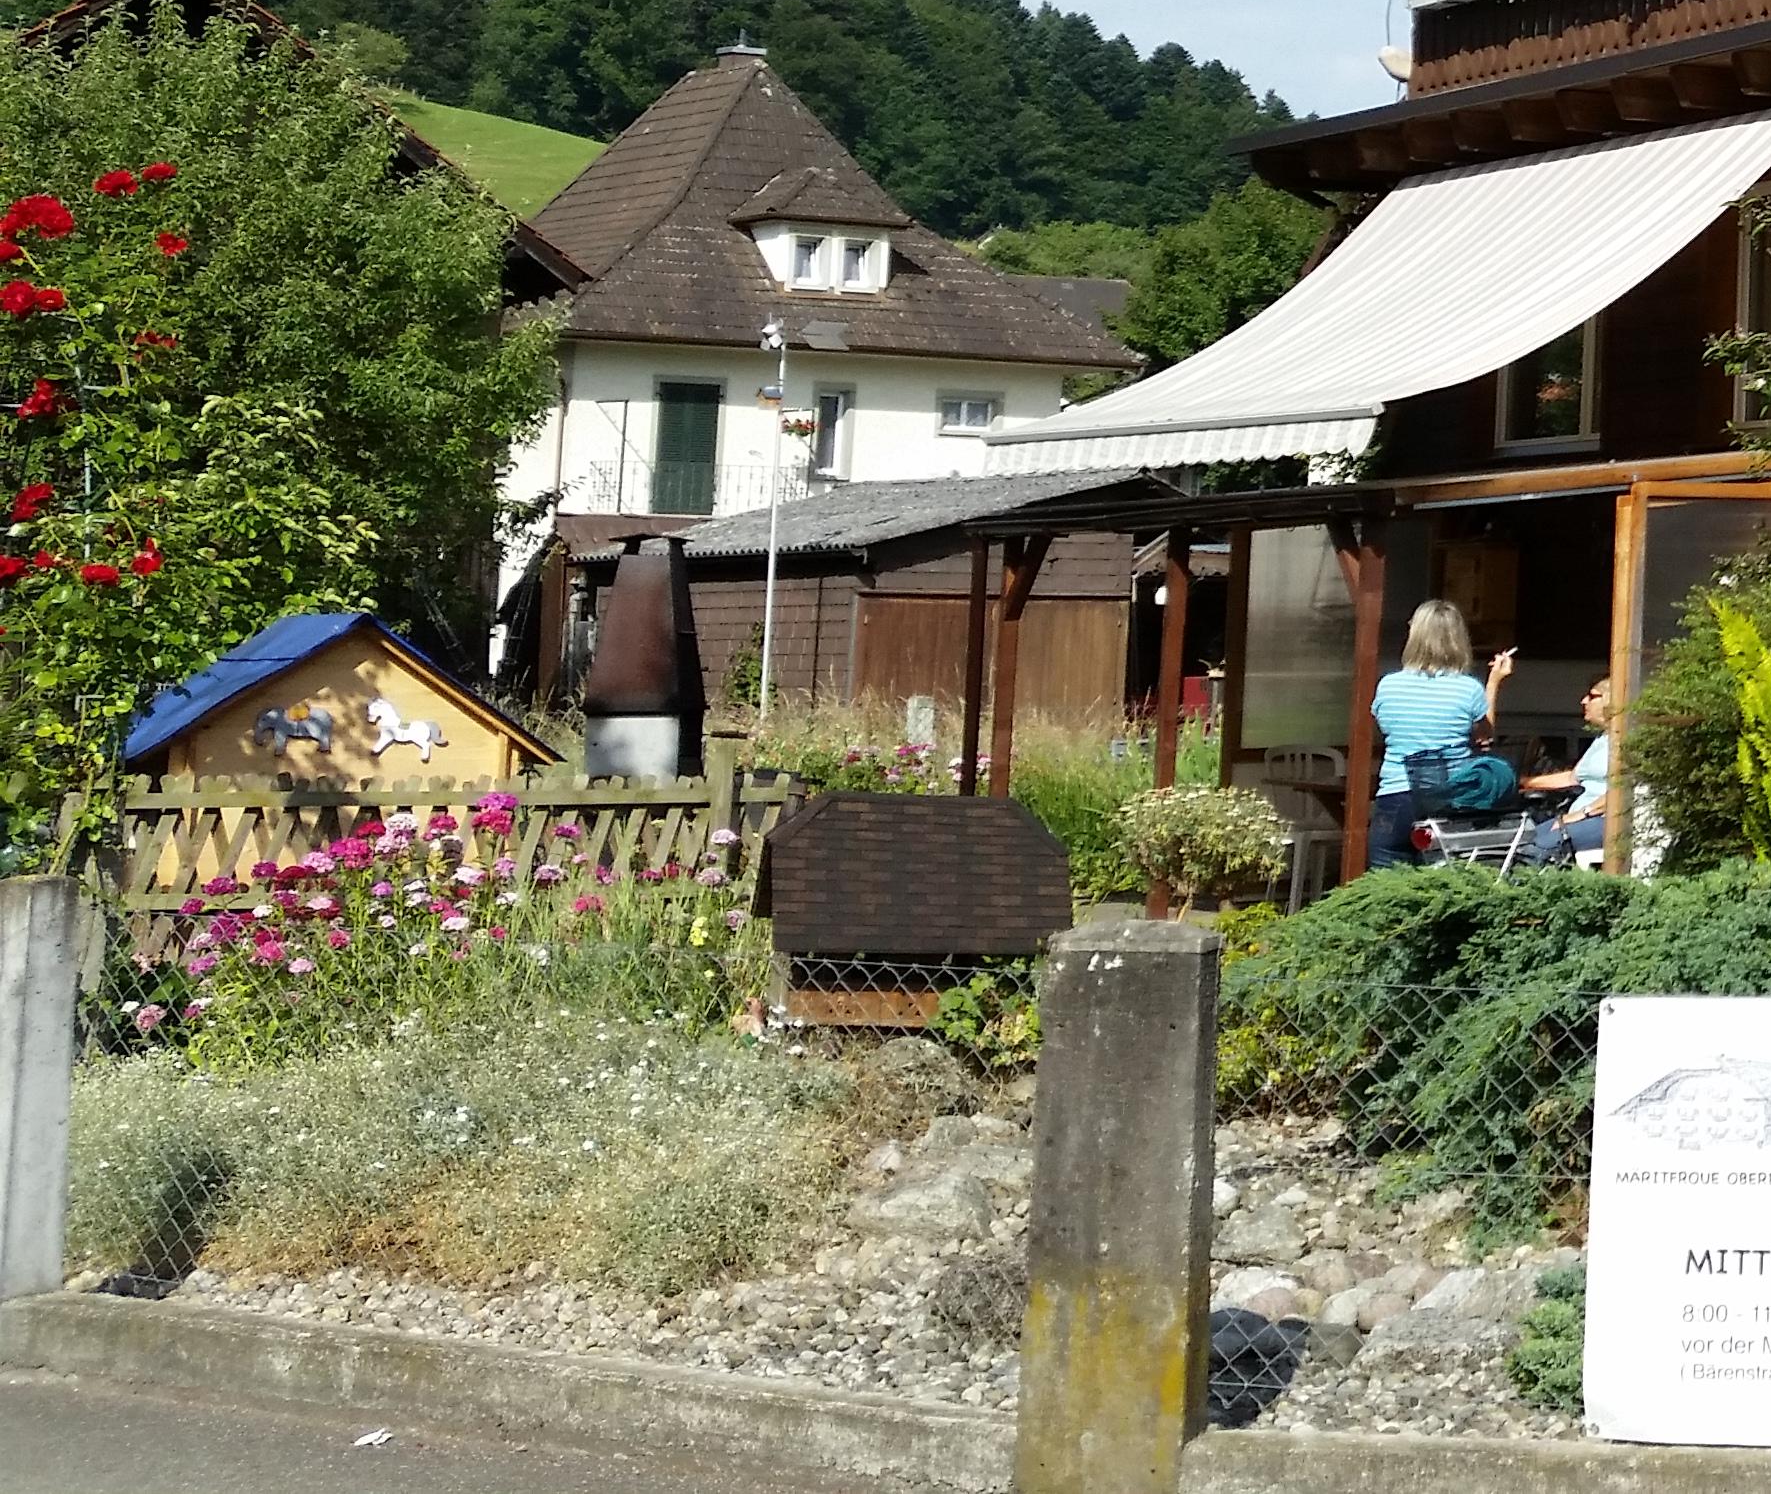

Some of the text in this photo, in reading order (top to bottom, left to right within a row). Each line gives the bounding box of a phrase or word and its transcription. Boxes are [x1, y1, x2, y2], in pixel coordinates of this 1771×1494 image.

[1682, 1304, 1729, 1323] 8:00
[1681, 1338, 1714, 1354] vor
[1720, 1335, 1755, 1355] der
